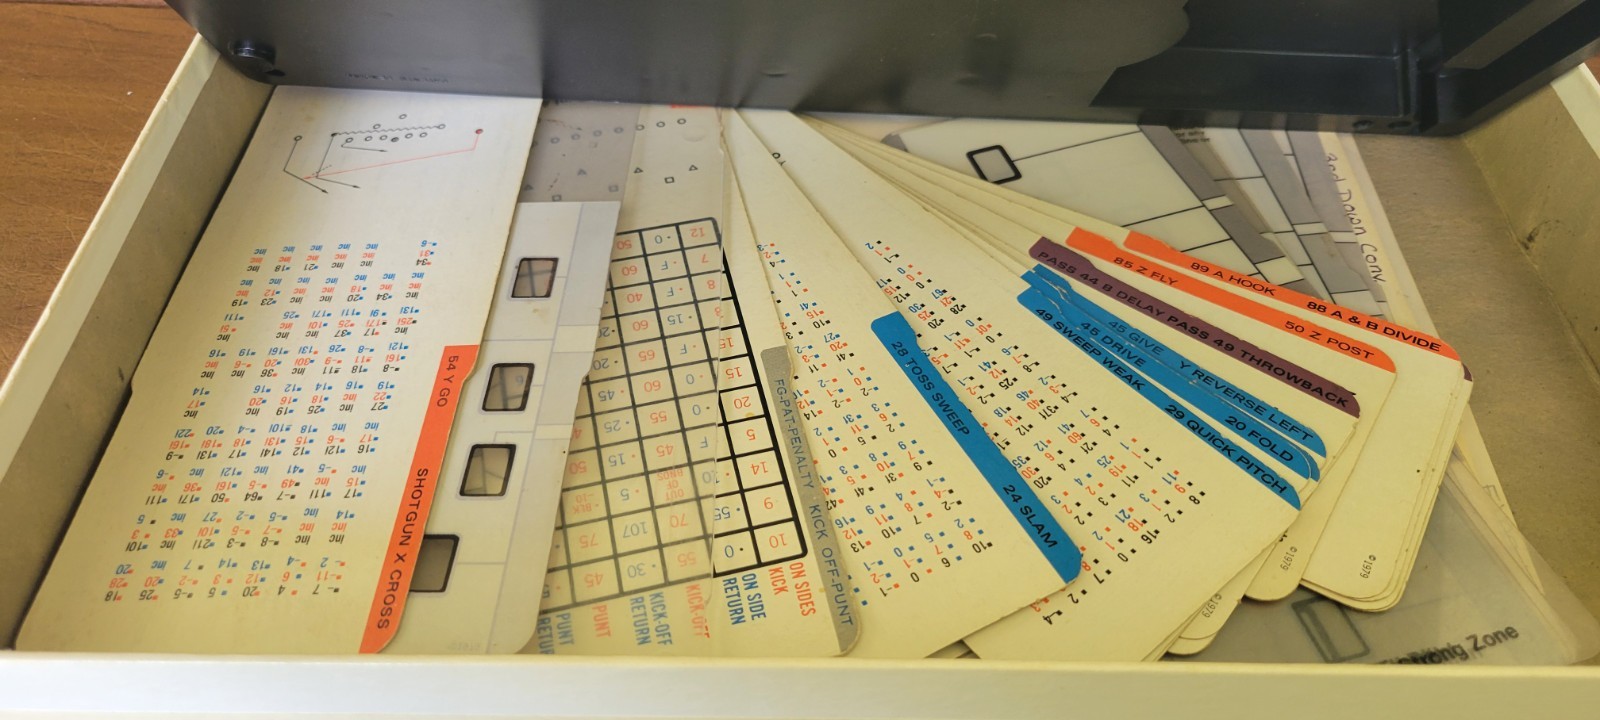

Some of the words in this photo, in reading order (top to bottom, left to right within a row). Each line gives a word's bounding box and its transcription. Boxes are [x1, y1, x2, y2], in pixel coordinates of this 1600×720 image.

[1339, 188, 1367, 236] Down
[655, 235, 663, 244] 0
[690, 228, 704, 238] 12
[616, 240, 632, 250] 50
[416, 258, 426, 266] 34
[702, 254, 709, 263] 7
[622, 266, 637, 276] 60
[661, 261, 668, 270] F
[1113, 256, 1133, 269] 85
[1136, 266, 1149, 274] Z
[1150, 271, 1179, 286] FLY
[707, 280, 715, 289] 8
[1038, 251, 1077, 274] PASS
[1079, 273, 1099, 285] 44
[1102, 283, 1113, 292] B
[1115, 290, 1166, 317] DELAY
[1190, 262, 1209, 274] 89
[1212, 270, 1224, 278] A
[1228, 275, 1276, 296] HOOK
[347, 294, 358, 302] 20
[627, 293, 643, 303] 40
[667, 287, 674, 296] F
[260, 298, 271, 306] 23
[633, 320, 649, 331] 60
[667, 314, 683, 325] 15
[1306, 300, 1327, 314] 88
[1331, 310, 1344, 319] A
[1348, 315, 1361, 325] &
[1366, 321, 1378, 331] B
[1382, 326, 1443, 352] DIVIDE
[1081, 322, 1099, 336] 45
[1101, 335, 1146, 368] DRIVE
[1108, 321, 1128, 334] 45
[1128, 332, 1165, 356] GIVE
[1285, 321, 1306, 333] 50
[1310, 331, 1324, 340] Z
[1326, 337, 1375, 360] POST
[638, 350, 655, 361] 65
[680, 344, 687, 354] F
[1035, 308, 1053, 322] 49
[1052, 321, 1101, 356] SWEEP
[1102, 356, 1146, 391] WEAK
[446, 354, 460, 370] 54
[592, 358, 609, 370] 20
[1167, 315, 1209, 340] PASS
[1213, 338, 1235, 352] 49
[1239, 349, 1349, 408] THROWBACK
[443, 374, 455, 384] Y
[686, 374, 694, 384] 0
[726, 366, 742, 379] 15
[644, 380, 661, 392] 60
[891, 341, 907, 357] 28
[907, 360, 935, 391] TOSS
[932, 391, 970, 436] SWEEP
[436, 388, 451, 408] GO
[598, 390, 615, 401] 45
[1179, 361, 1191, 370] Y
[1190, 370, 1267, 415] REVERSE
[1268, 413, 1313, 442] LEFT
[339, 404, 354, 412] inc
[370, 402, 383, 411] 27
[734, 396, 750, 409] 20
[246, 408, 260, 416] inc
[276, 407, 289, 416] 19
[307, 405, 320, 414] 25
[693, 404, 700, 415] 0
[650, 411, 667, 423] 55
[604, 420, 620, 433] 25
[746, 430, 756, 440] 5
[774, 378, 815, 490] FG-PAT-PENALTY
[1225, 415, 1248, 431] 20
[1248, 428, 1294, 463] FOLD
[700, 437, 707, 448] F
[656, 445, 674, 457] 45
[1164, 405, 1186, 422] 29
[1186, 419, 1236, 457] QUICK
[1236, 454, 1288, 494] PITCH
[609, 454, 625, 466] 15
[569, 461, 586, 475] 50
[751, 460, 769, 475] 14
[667, 480, 679, 489] OF
[211, 493, 224, 503] 50
[244, 492, 257, 501] 64
[344, 488, 357, 498] 17
[620, 488, 630, 501] 5
[666, 489, 684, 501] OUT
[1189, 494, 1201, 505] 8
[398, 468, 429, 547] SHOTGUN
[764, 497, 773, 510] 9
[670, 514, 688, 528] 70
[1003, 484, 1022, 503] 24
[1020, 504, 1058, 549] SLAM
[623, 522, 648, 537] 107
[579, 534, 599, 548] 75
[770, 533, 788, 548] 10
[394, 552, 406, 563] X
[725, 545, 734, 558] 0
[678, 553, 696, 566] 55
[809, 504, 829, 540] KICK
[821, 547, 854, 626] OFF-PUNT
[627, 564, 646, 578] 30
[790, 562, 804, 578] ON
[584, 574, 604, 588] 45
[741, 573, 756, 590] ON
[768, 567, 788, 595] KICK
[104, 591, 116, 602] 18
[139, 590, 152, 600] 25
[208, 587, 216, 598] 5
[242, 586, 254, 597] 20
[377, 568, 402, 630] CROSS
[722, 577, 746, 625] RETURN
[794, 580, 816, 617] SIDES
[747, 592, 766, 621] SIDE
[592, 604, 611, 638] PUNT
[630, 596, 652, 646] RETURN
[649, 592, 673, 646] KICK-OFF
[537, 616, 555, 654] RETUR
[556, 612, 575, 646] PUNT
[1466, 624, 1520, 651] Zone
